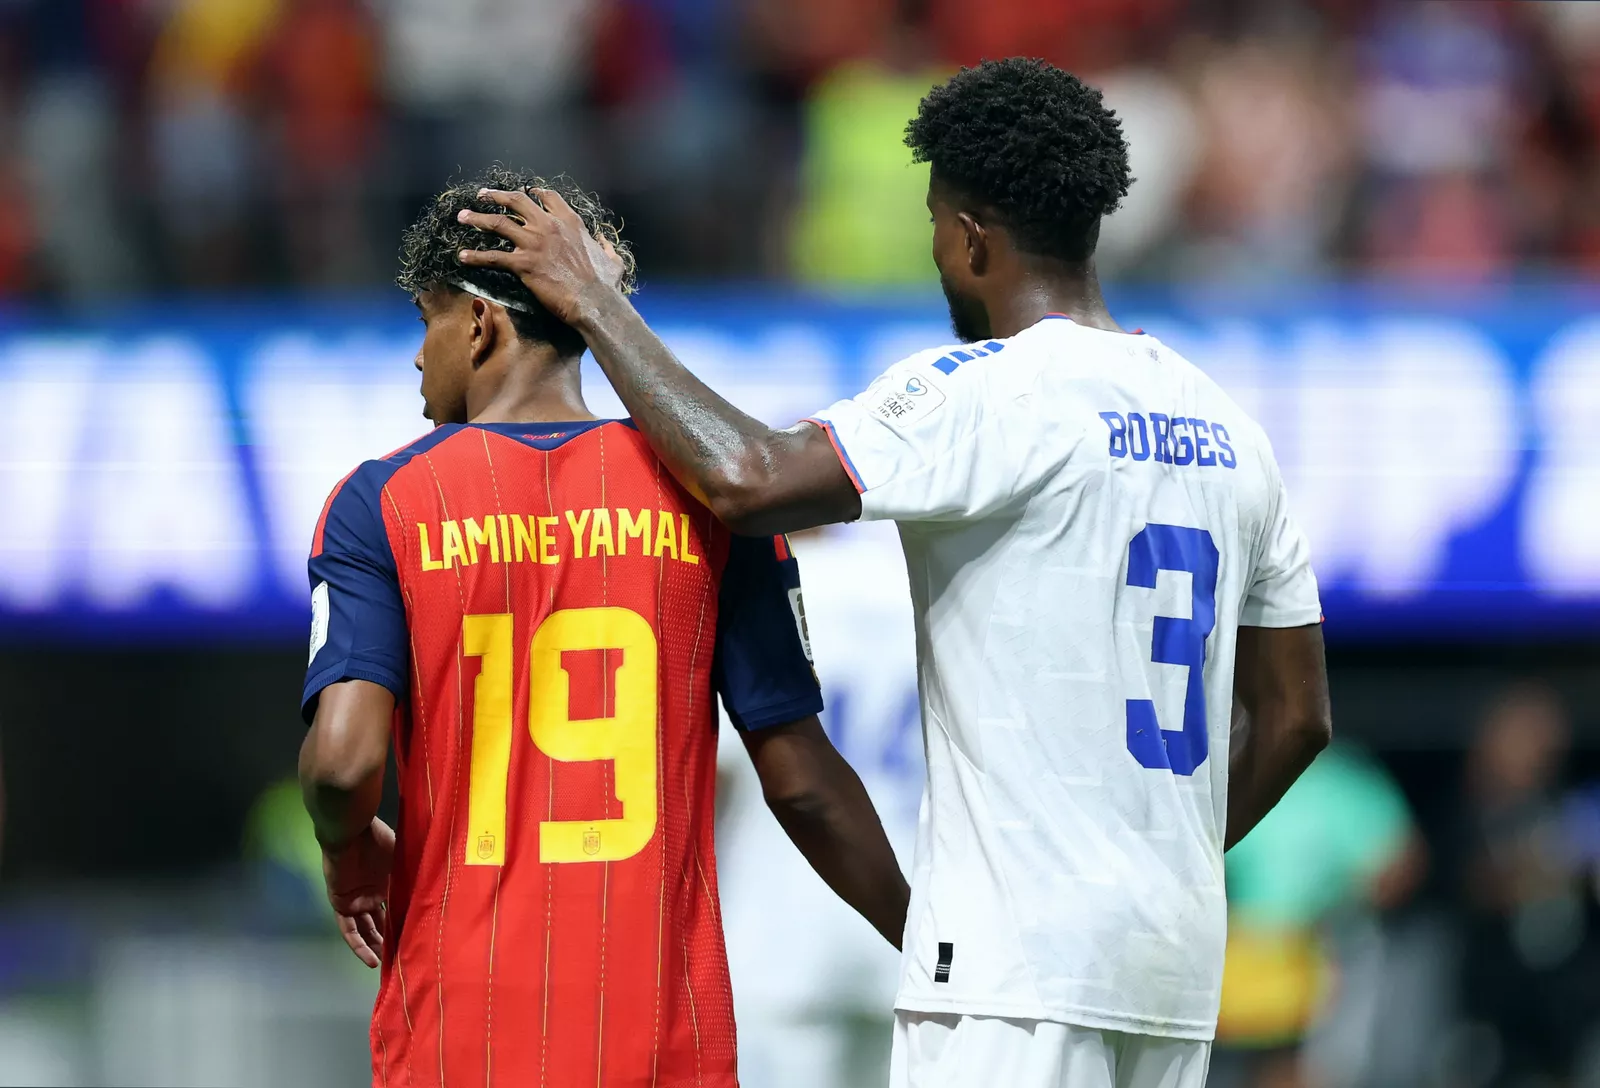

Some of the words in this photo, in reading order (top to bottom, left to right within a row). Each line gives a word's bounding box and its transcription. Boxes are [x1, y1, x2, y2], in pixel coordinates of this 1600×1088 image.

[883, 396, 907, 419] EACE
[1099, 411, 1237, 469] BORGES
[418, 515, 560, 571] LAMINE
[565, 508, 700, 565] YAMAL
[1126, 523, 1220, 776] 3
[463, 607, 657, 866] 19
